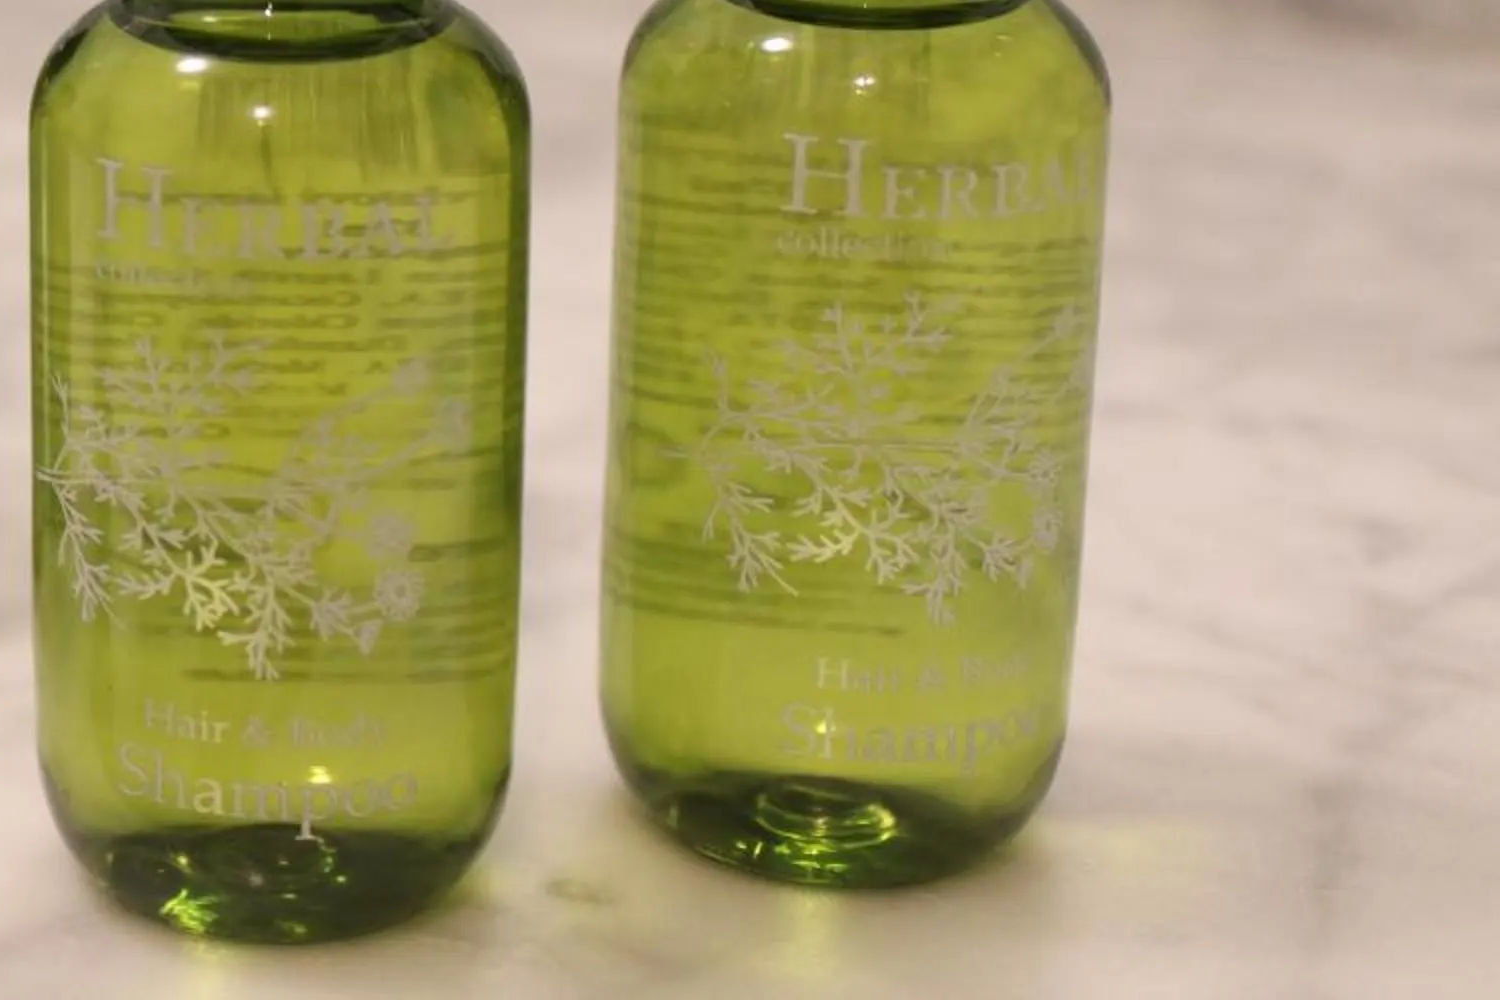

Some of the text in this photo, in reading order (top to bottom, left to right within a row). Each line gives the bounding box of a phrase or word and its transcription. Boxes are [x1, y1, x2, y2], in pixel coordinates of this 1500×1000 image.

[95, 155, 455, 265] HERBAL
[143, 695, 231, 745] Hair
[240, 713, 274, 750] &
[116, 740, 419, 843] Shampoo
